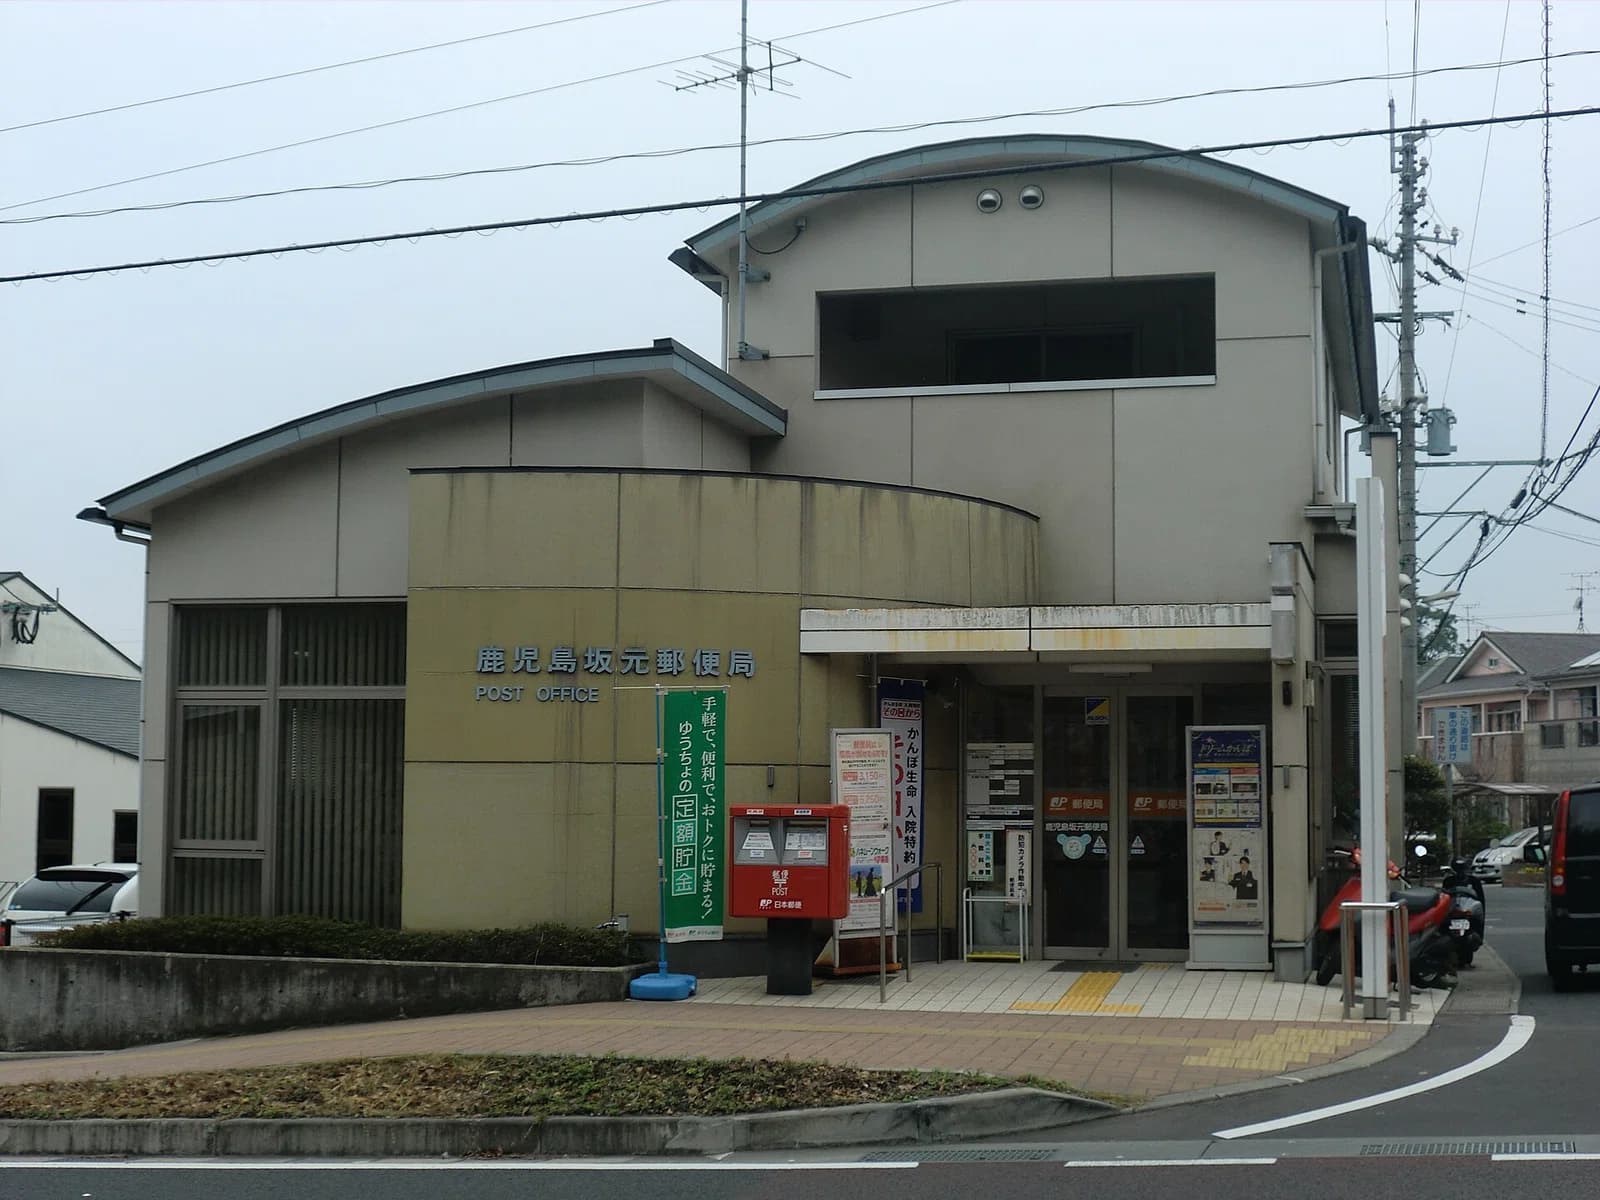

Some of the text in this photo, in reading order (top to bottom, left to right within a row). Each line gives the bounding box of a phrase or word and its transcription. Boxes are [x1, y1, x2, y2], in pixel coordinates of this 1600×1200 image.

[476, 645, 757, 679] 鹿児島坂元郵便局
[475, 686, 600, 703] POST OFFICE
[903, 805, 917, 864] 入院特約
[771, 887, 788, 896] POST
